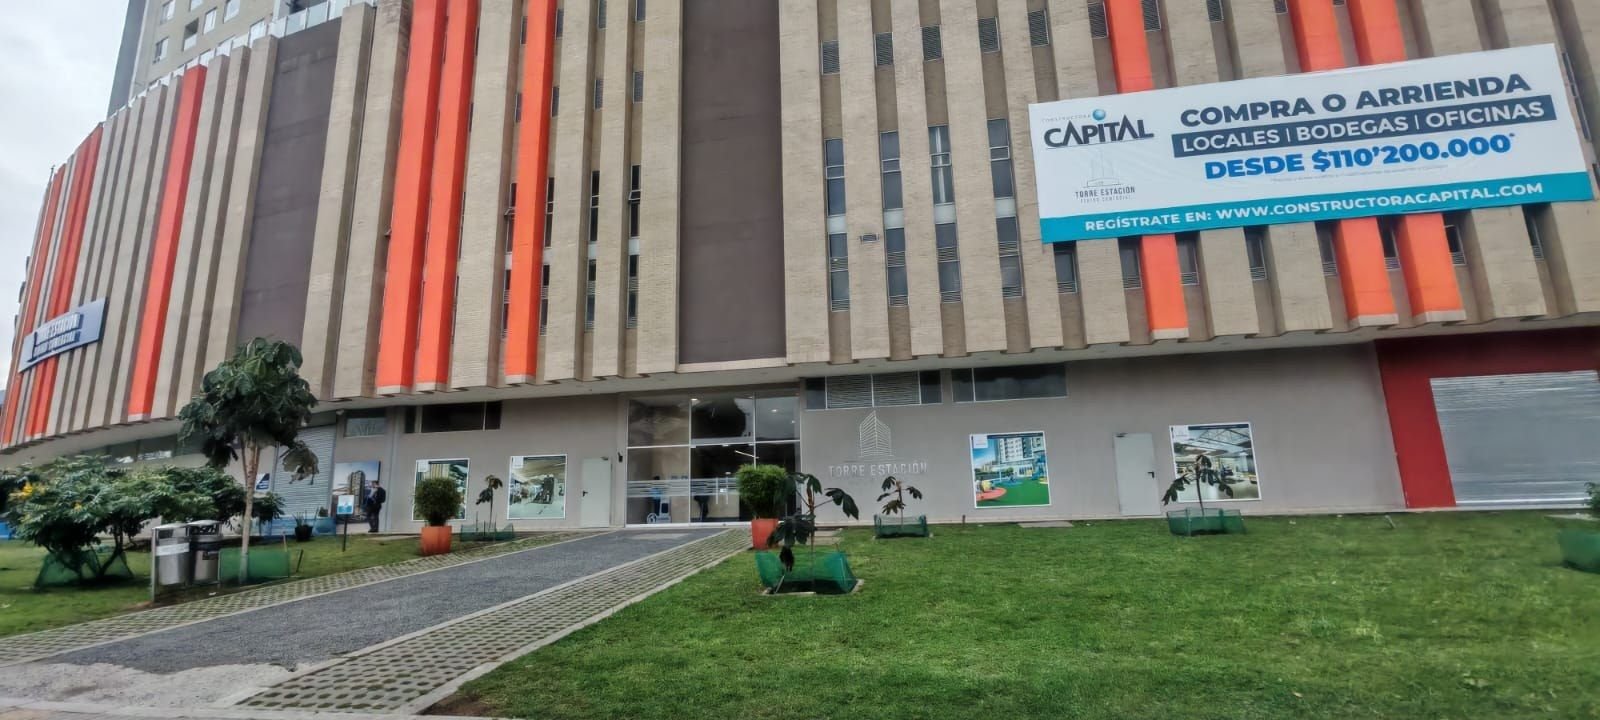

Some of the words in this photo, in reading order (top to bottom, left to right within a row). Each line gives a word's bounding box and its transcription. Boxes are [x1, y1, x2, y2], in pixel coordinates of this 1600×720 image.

[1180, 97, 1315, 127] COMPRA
[1322, 93, 1346, 112] O
[1355, 73, 1531, 109] ARRIENDA
[1044, 110, 1154, 148] CAPITAL
[1182, 129, 1280, 152] LOCALES
[1296, 116, 1408, 141] BODEGAS
[1425, 101, 1545, 128] OFICINAS
[1205, 154, 1304, 179] DESDE
[1075, 189, 1098, 199] TORRE
[1085, 213, 1180, 231] REGÍSTRATE
[1185, 211, 1211, 223] EN:
[1216, 182, 1543, 220] WWW.CONSTRUCTORACAPITAL.COM
[829, 464, 865, 477] TORRE
